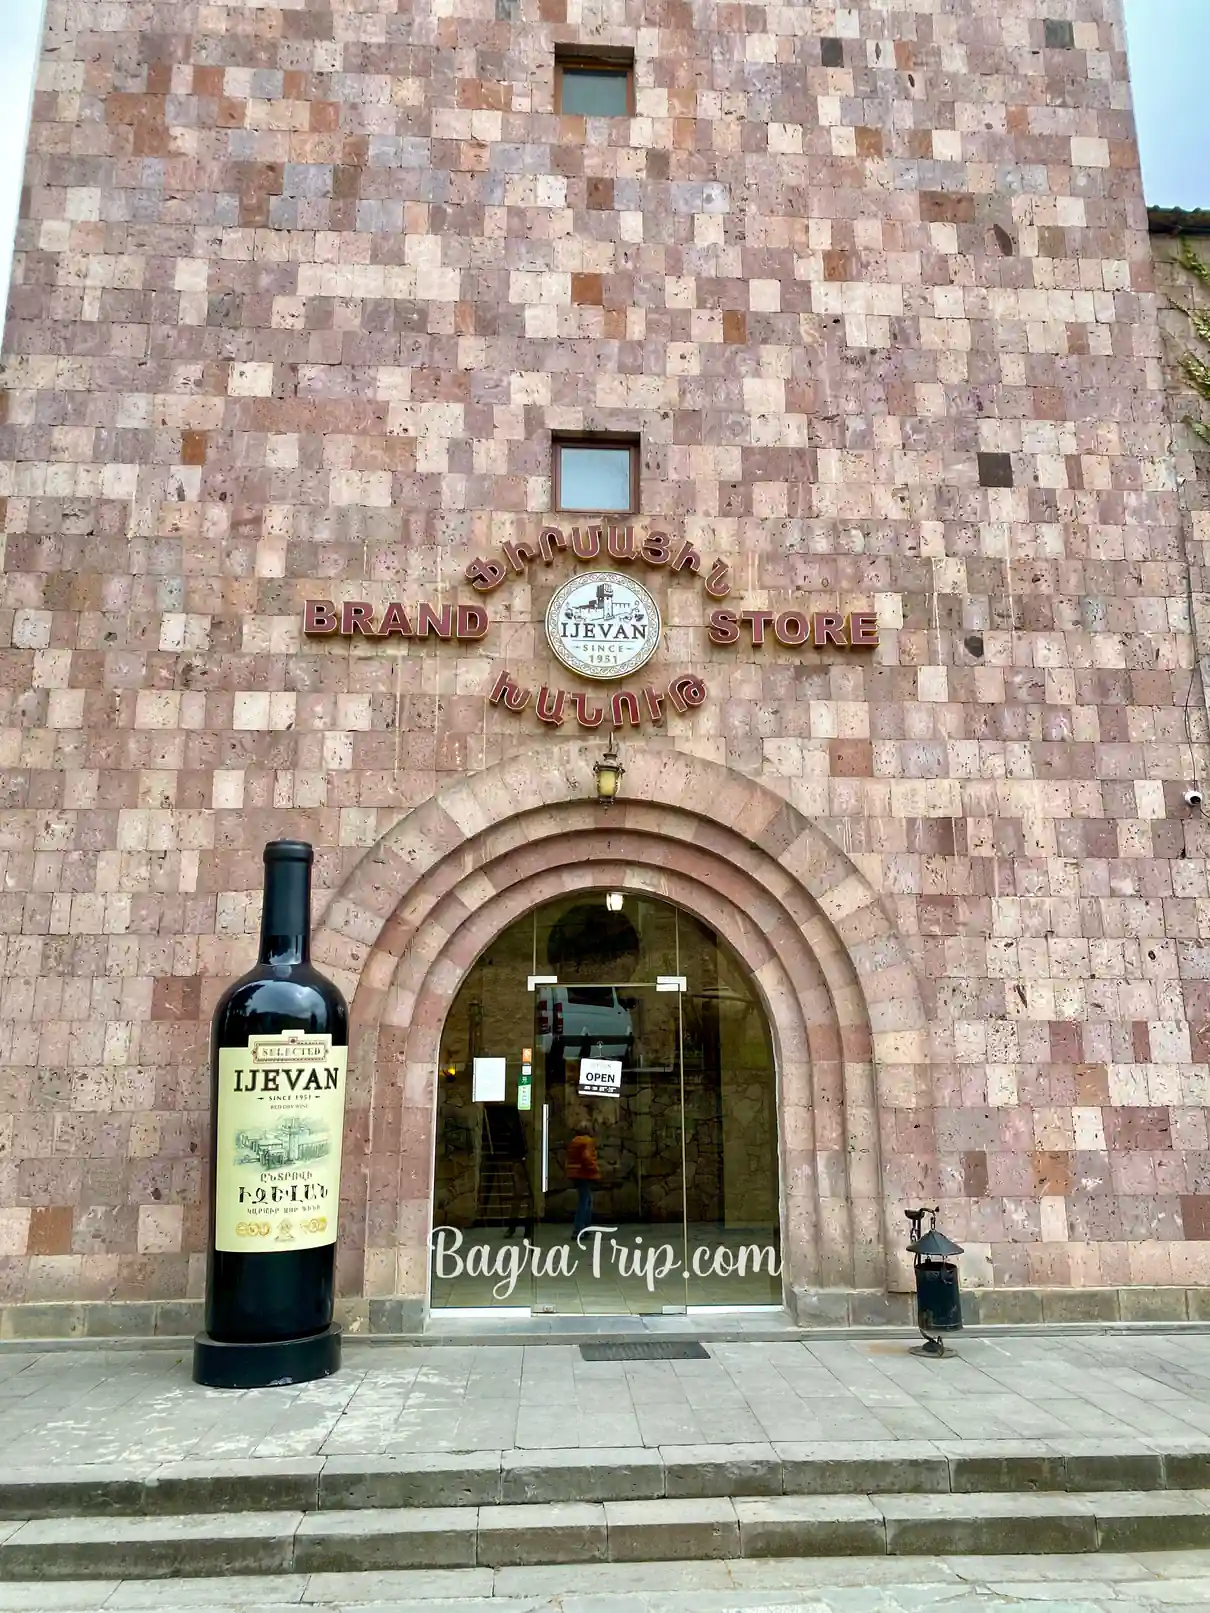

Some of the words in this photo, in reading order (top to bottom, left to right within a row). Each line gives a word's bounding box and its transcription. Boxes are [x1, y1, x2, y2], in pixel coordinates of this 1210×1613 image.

[303, 599, 489, 642] BRAND
[708, 608, 880, 648] STORE
[560, 622, 648, 640] IJEVAN
[583, 644, 625, 653] SINCE
[589, 654, 618, 664] 1951
[488, 670, 708, 728] ԽԱՆՈՒԹ
[262, 1047, 321, 1057] SELECTED
[233, 1067, 339, 1092] IJEVAN
[585, 1072, 616, 1084] OPEN
